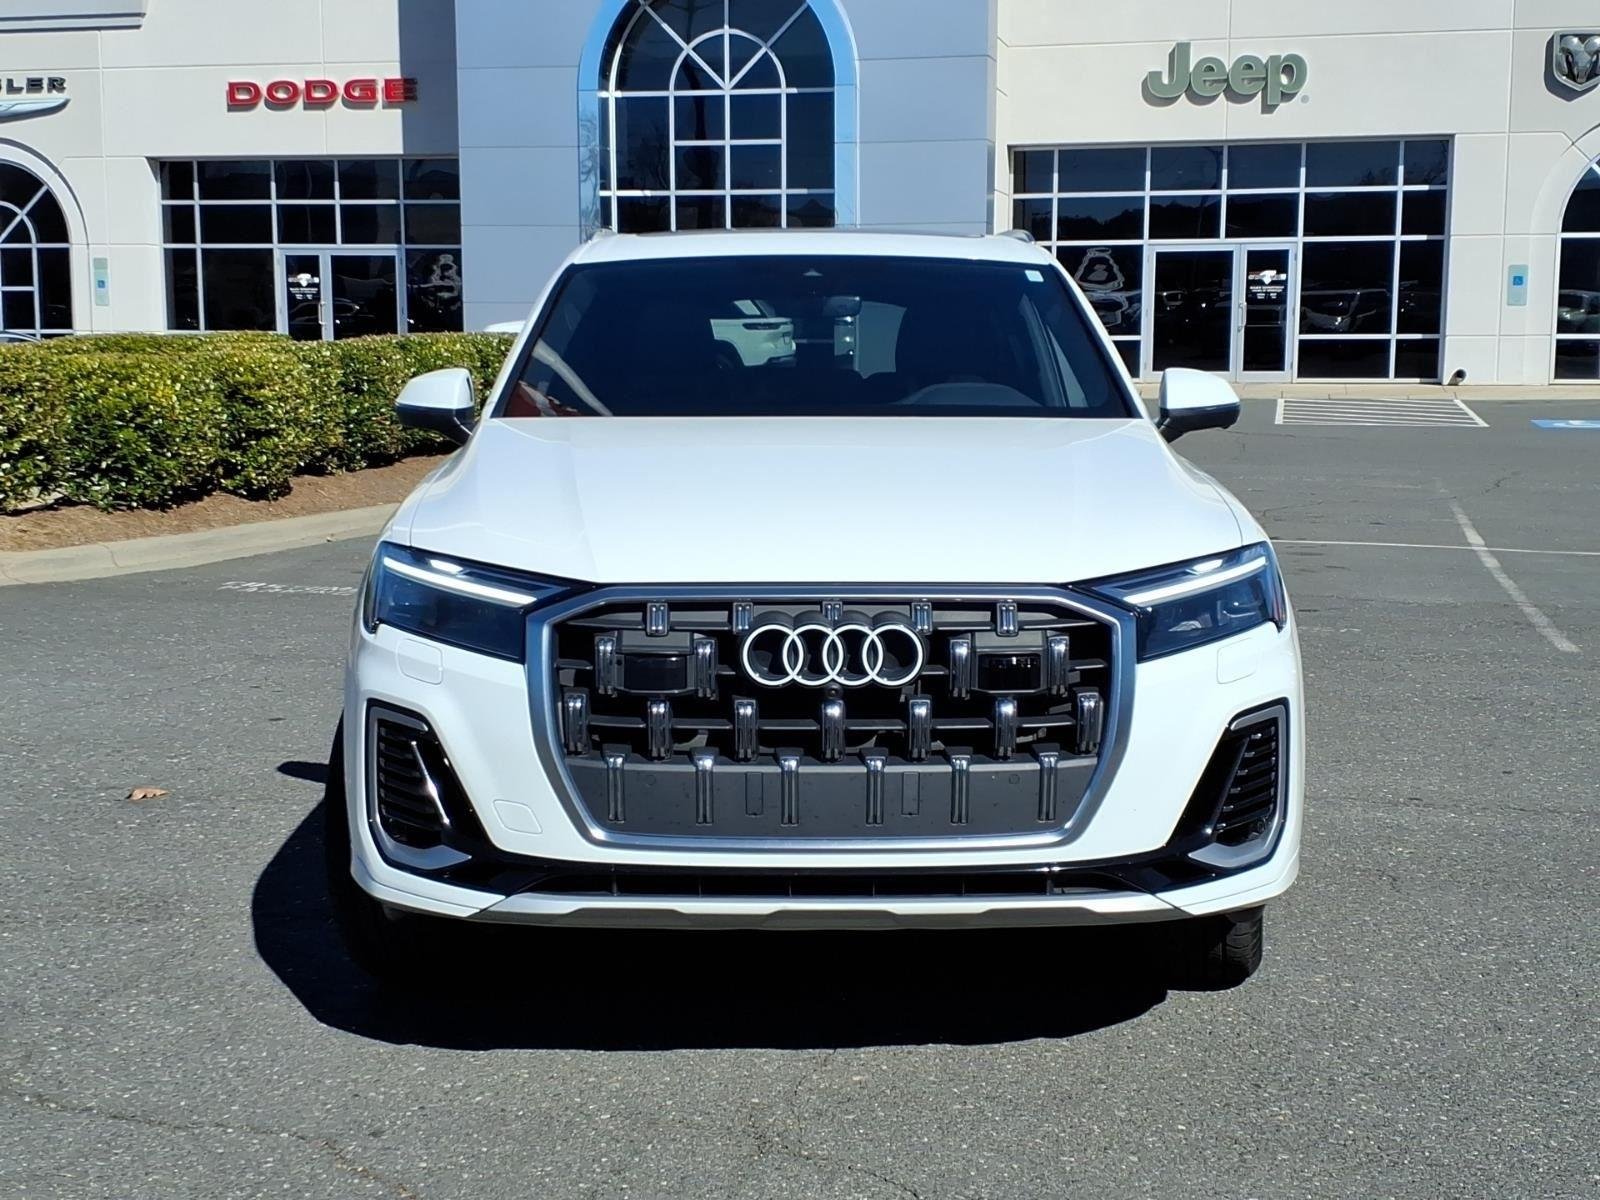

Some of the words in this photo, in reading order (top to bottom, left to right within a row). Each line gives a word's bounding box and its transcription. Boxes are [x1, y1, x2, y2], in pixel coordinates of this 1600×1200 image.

[0, 77, 66, 94] LER
[1146, 42, 1307, 106] Jeep
[227, 78, 417, 106] DODGE
